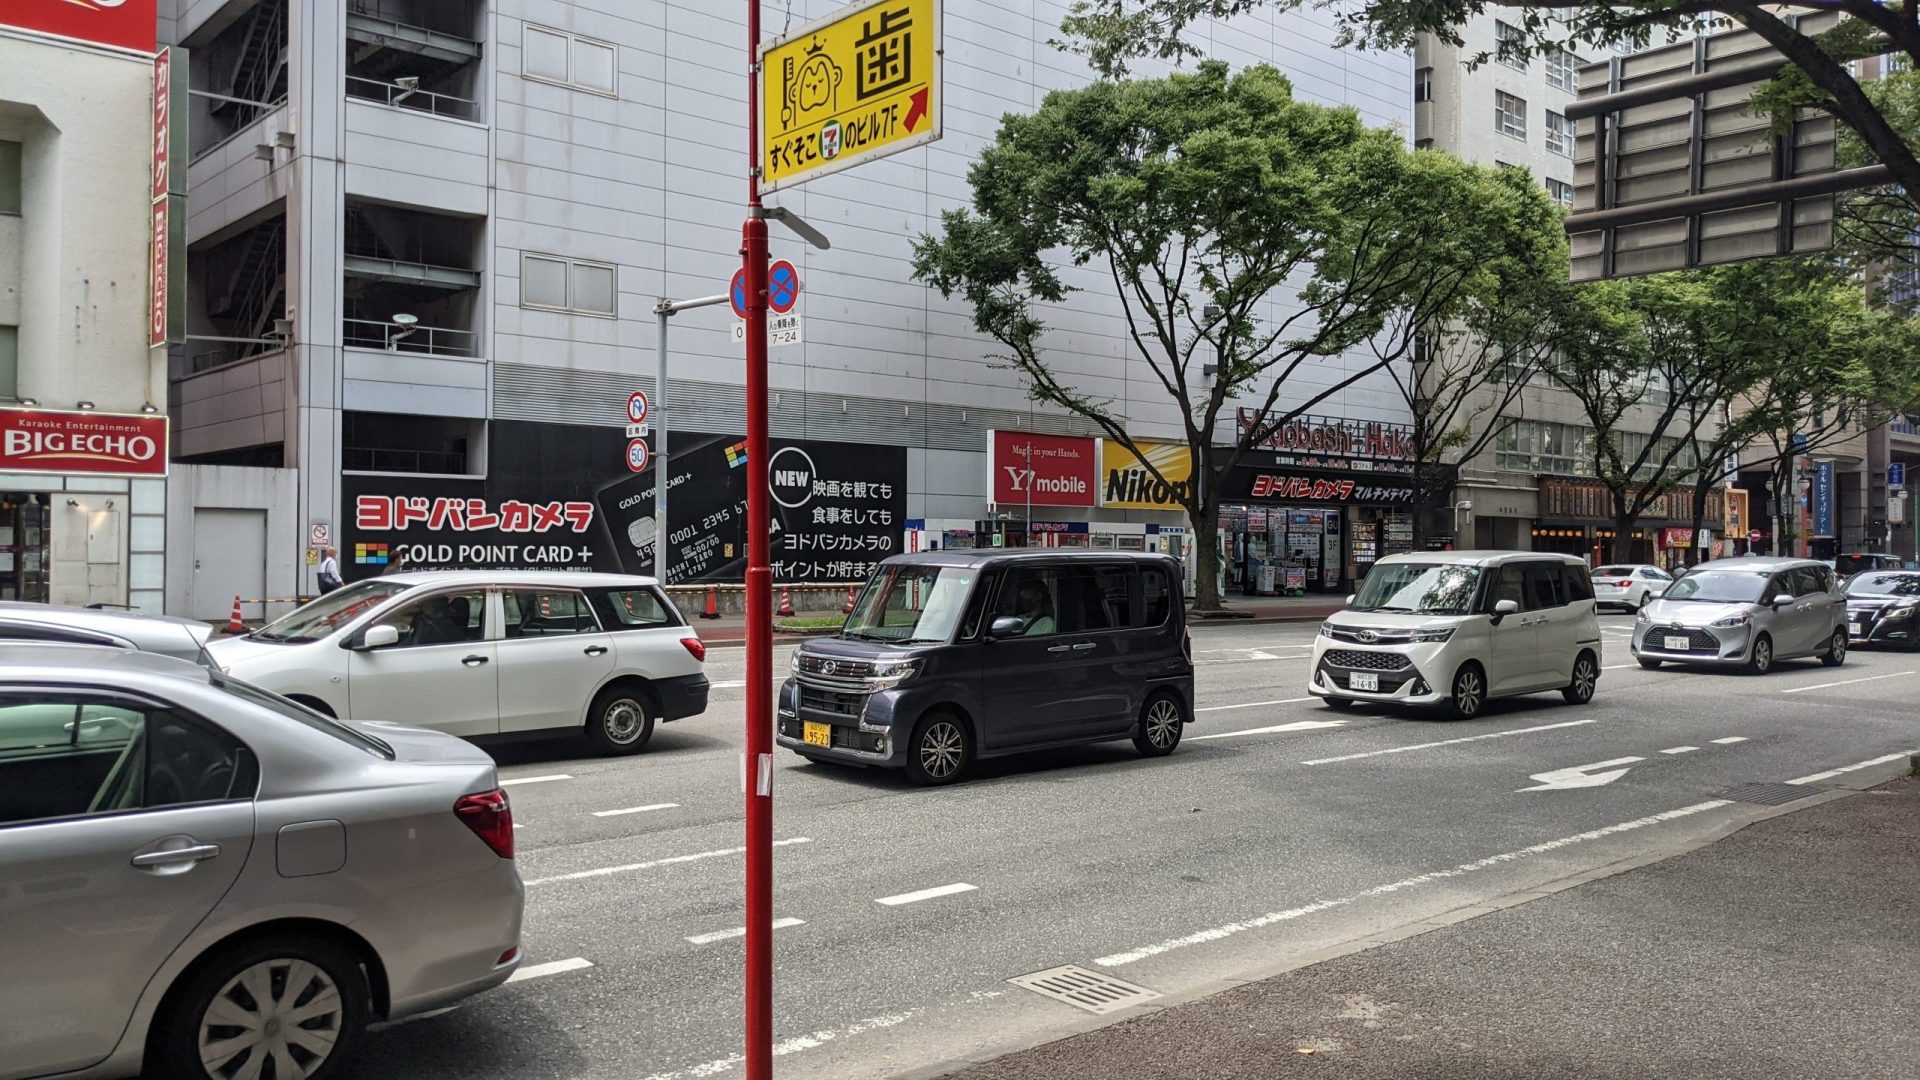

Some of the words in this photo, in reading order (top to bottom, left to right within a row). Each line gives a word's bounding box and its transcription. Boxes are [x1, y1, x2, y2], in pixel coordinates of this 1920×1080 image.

[855, 7, 912, 101] 歯
[155, 61, 167, 188] カラオケ
[770, 132, 817, 174] すぐそこ
[845, 104, 898, 149] のビル7F
[772, 331, 796, 344] 7-24
[18, 419, 62, 429] Karaoke
[66, 421, 141, 433] Entertainment
[4, 429, 65, 456] BIG
[71, 434, 156, 461] ECHO
[631, 447, 643, 462] 50
[1034, 448, 1041, 457] in
[1041, 449, 1057, 459] your
[775, 470, 809, 487] NEW
[812, 479, 892, 499] 映画を観ても
[1106, 469, 1187, 504] Nikon
[1252, 475, 1355, 500] ヨドバシカメラ
[1354, 485, 1414, 503] マルチメディア
[619, 494, 641, 510] GOLD
[641, 486, 656, 501] POI
[665, 474, 685, 489] CARD
[355, 494, 595, 533] ヨドバシカメラ
[812, 506, 892, 525] 食事をしても
[669, 524, 699, 545] 0001
[702, 508, 730, 530] 2345
[784, 533, 892, 551] ヨドバシカメラの
[395, 544, 453, 563] GOLD
[458, 544, 518, 563] POINT
[523, 545, 574, 564] CARD
[666, 561, 690, 577] BASHI
[695, 550, 713, 565] TARO
[809, 731, 829, 746] 95-23
